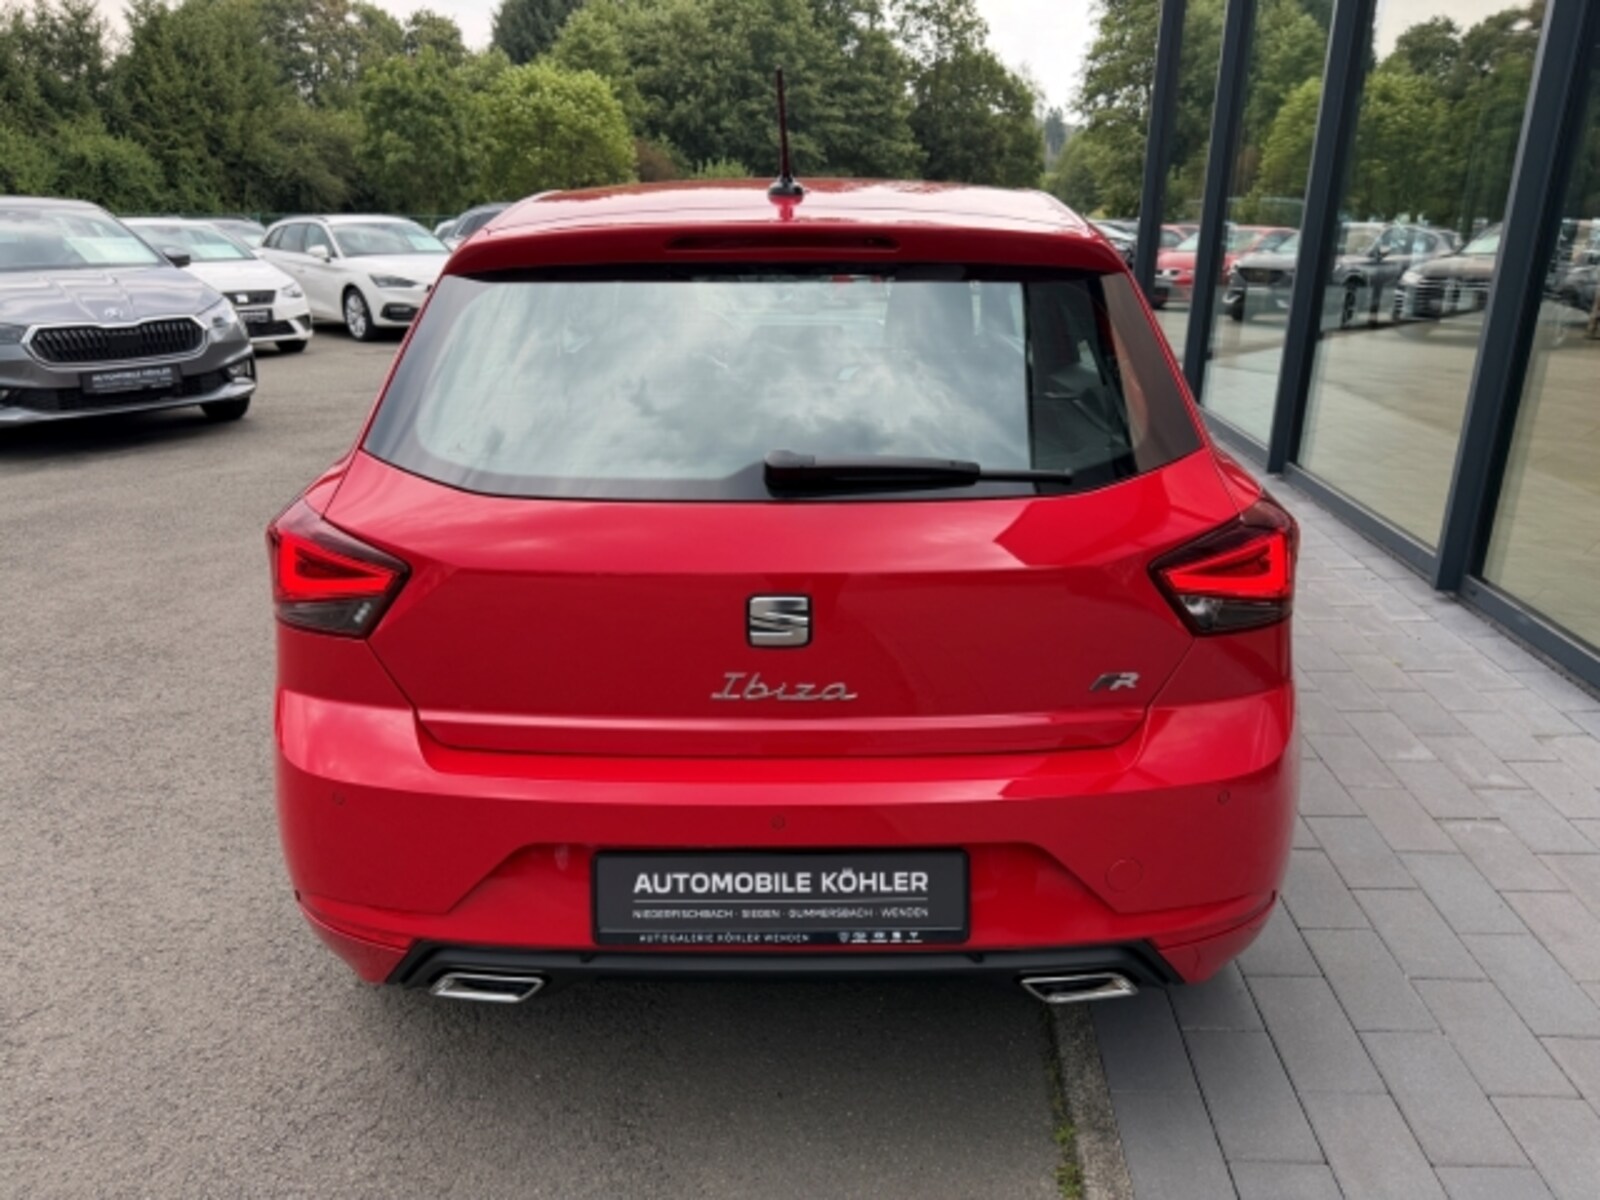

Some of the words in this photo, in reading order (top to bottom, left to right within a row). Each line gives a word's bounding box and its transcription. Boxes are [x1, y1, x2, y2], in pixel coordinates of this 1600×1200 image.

[709, 671, 858, 702] Ibiza
[633, 871, 812, 894] AUTOMOBILE
[821, 867, 929, 893] KÖHLER
[881, 906, 929, 918] WENDEN
[717, 931, 760, 943] KÖHLER
